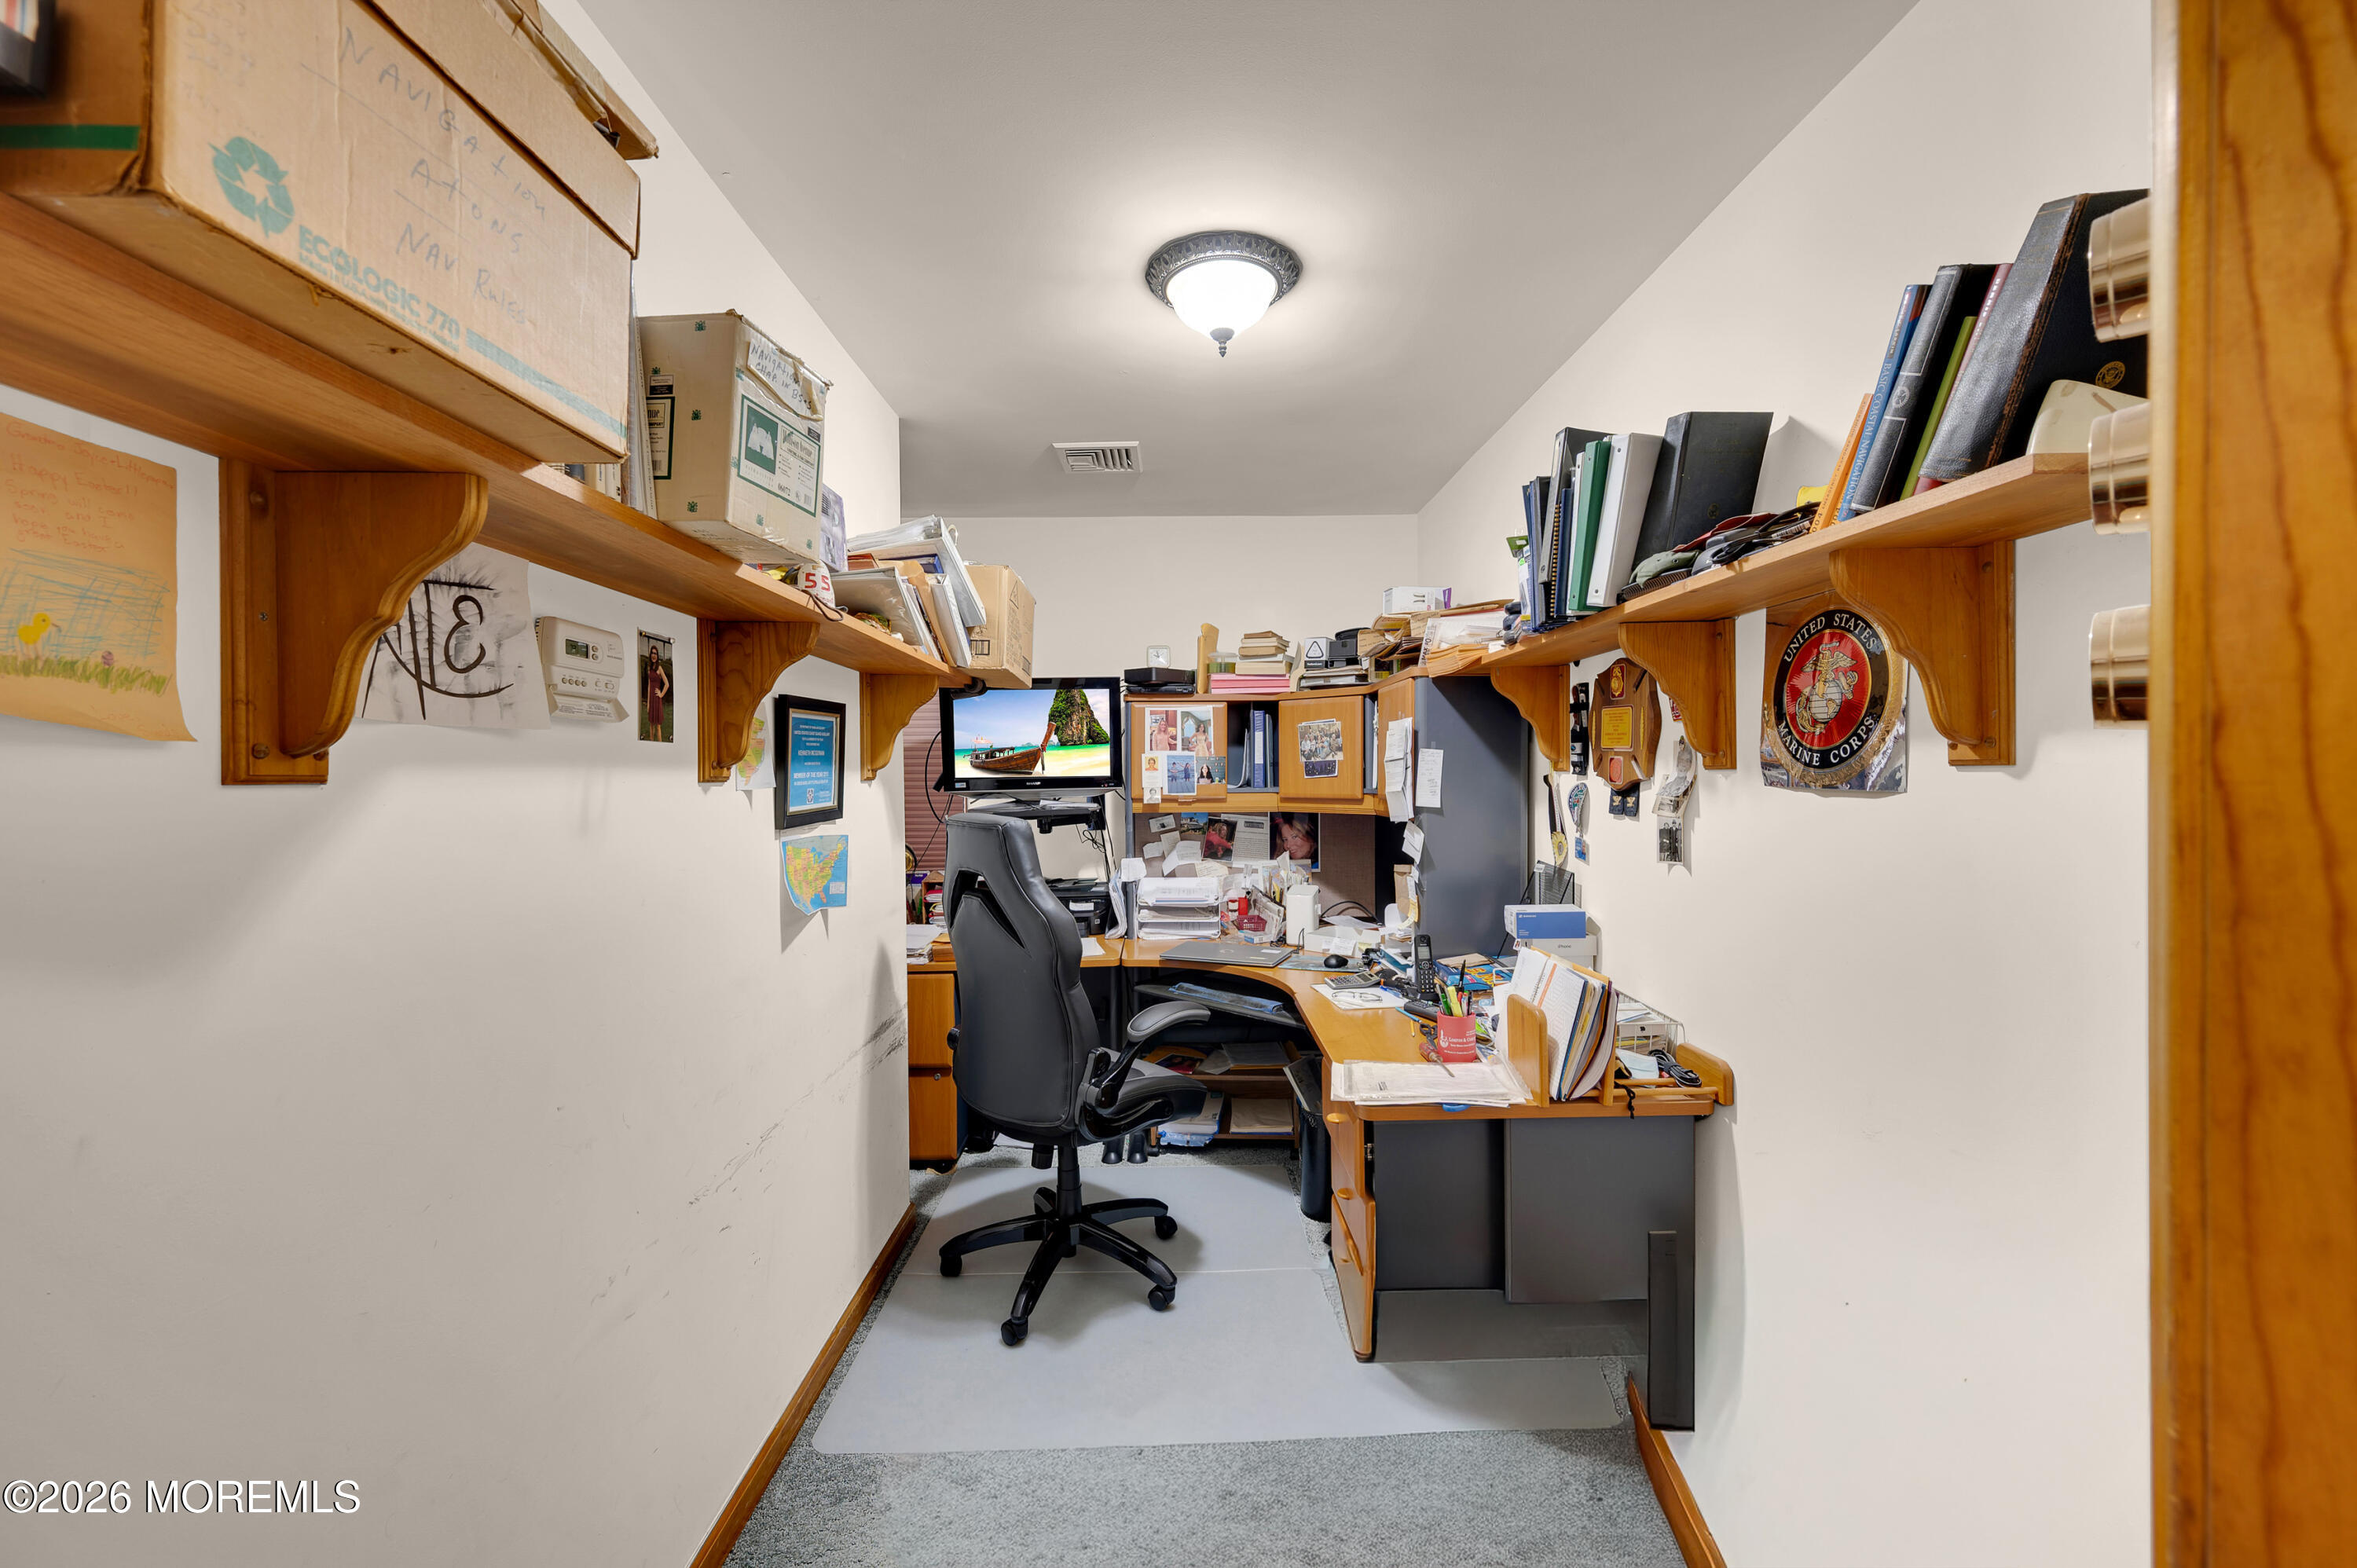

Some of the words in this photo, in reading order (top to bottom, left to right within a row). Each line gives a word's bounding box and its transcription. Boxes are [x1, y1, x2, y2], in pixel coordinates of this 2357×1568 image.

[299, 225, 421, 318] ECOLOGIC
[427, 302, 460, 340] 770
[1877, 363, 1893, 393] BASIC
[1864, 393, 1884, 436] COASTAL
[10, 452, 69, 492] Happy
[1846, 439, 1871, 500] NAVIGATION
[1809, 513, 1823, 533] 004
[1783, 615, 1826, 663] UNITED
[1833, 613, 1876, 650] STATES
[1778, 720, 1820, 766] MARINE
[1830, 716, 1875, 764] CORPS
